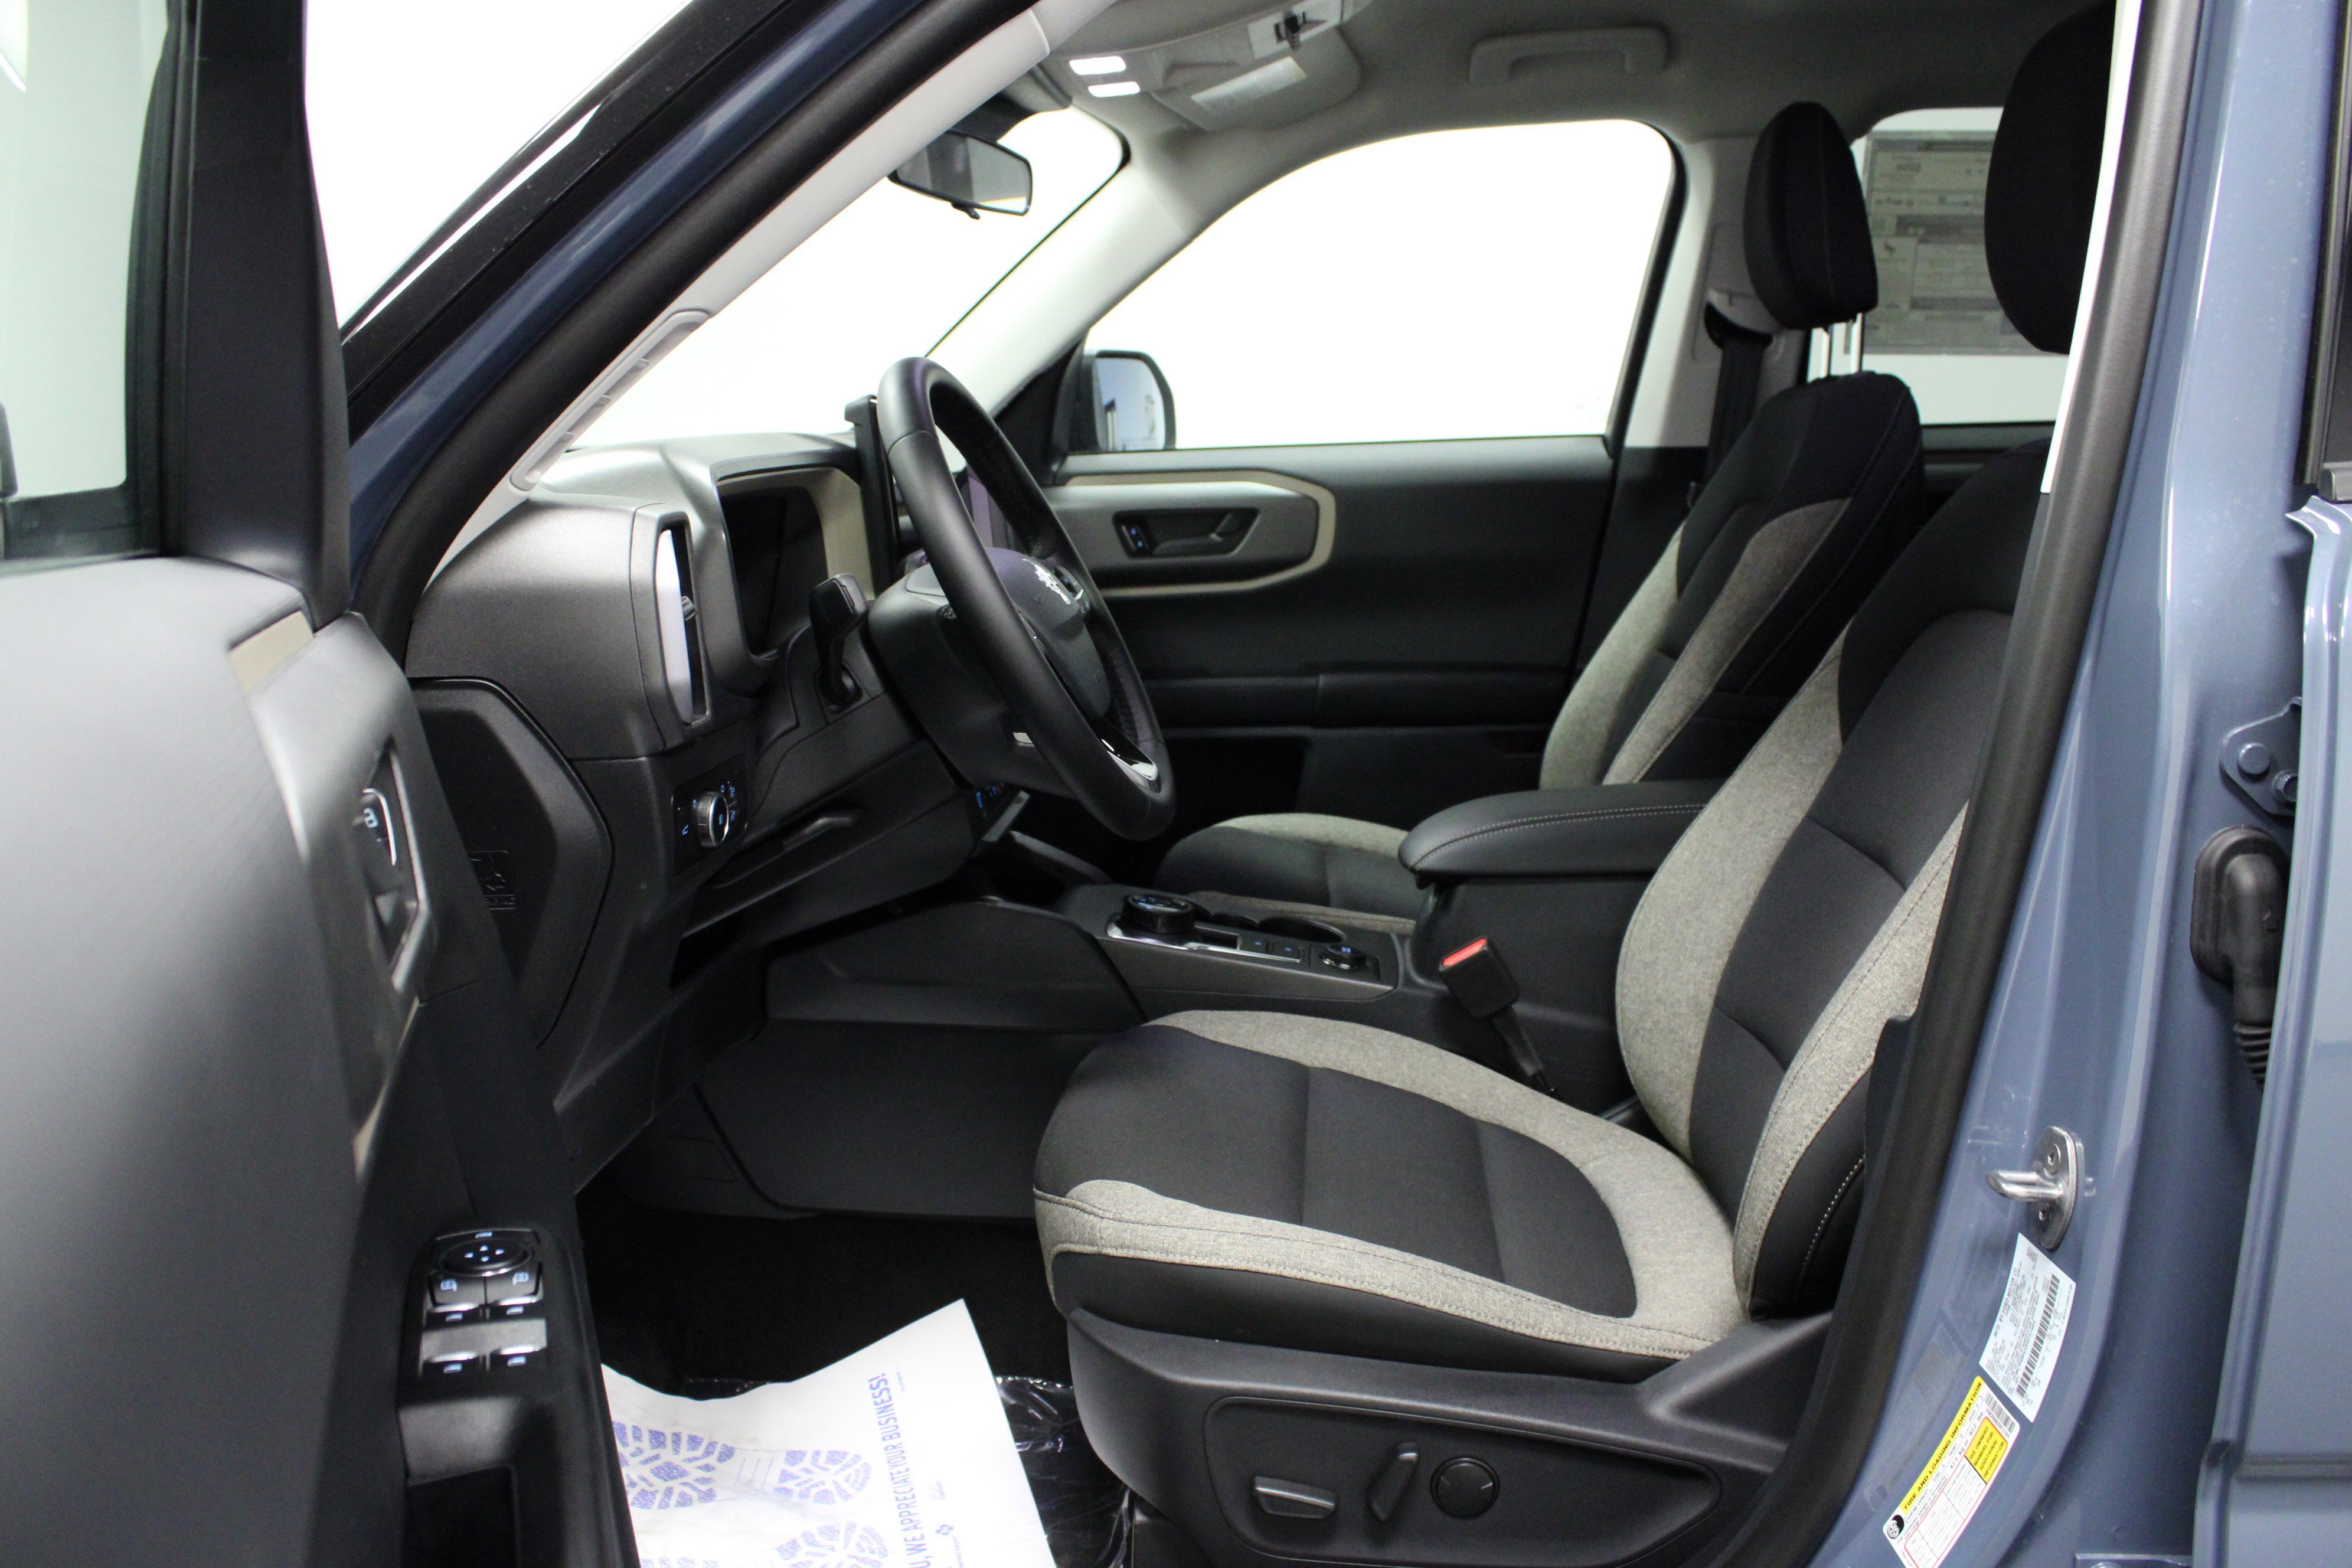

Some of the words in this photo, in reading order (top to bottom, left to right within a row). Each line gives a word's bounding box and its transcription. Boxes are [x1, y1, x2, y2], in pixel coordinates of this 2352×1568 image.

[1998, 1313, 2004, 1322] BY
[2001, 1296, 2009, 1314] FORD
[2006, 1276, 2015, 1298] MOTOR
[868, 1373, 901, 1442] BUSINESS!
[884, 1442, 909, 1470] YOUR
[1903, 1491, 1917, 1511] TIRE
[1916, 1473, 1929, 1492] AND
[1928, 1438, 1951, 1475] LOADING
[1950, 1381, 1982, 1439] INFORMATION
[1949, 1456, 1958, 1470] 413
[1958, 1446, 1965, 1455] kg
[1963, 1438, 1969, 1447] or
[1969, 1422, 1977, 1436] 912
[1972, 1442, 1988, 1466] MANUAL
[1986, 1430, 1994, 1444] FOR
[1975, 1425, 1990, 1450] OWNERS
[1978, 1438, 1998, 1471] ADDITIONAL
[1982, 1440, 2005, 1479] INFORMATION
[889, 1468, 923, 1532] APPRECIATE
[903, 1533, 927, 1556] WE
